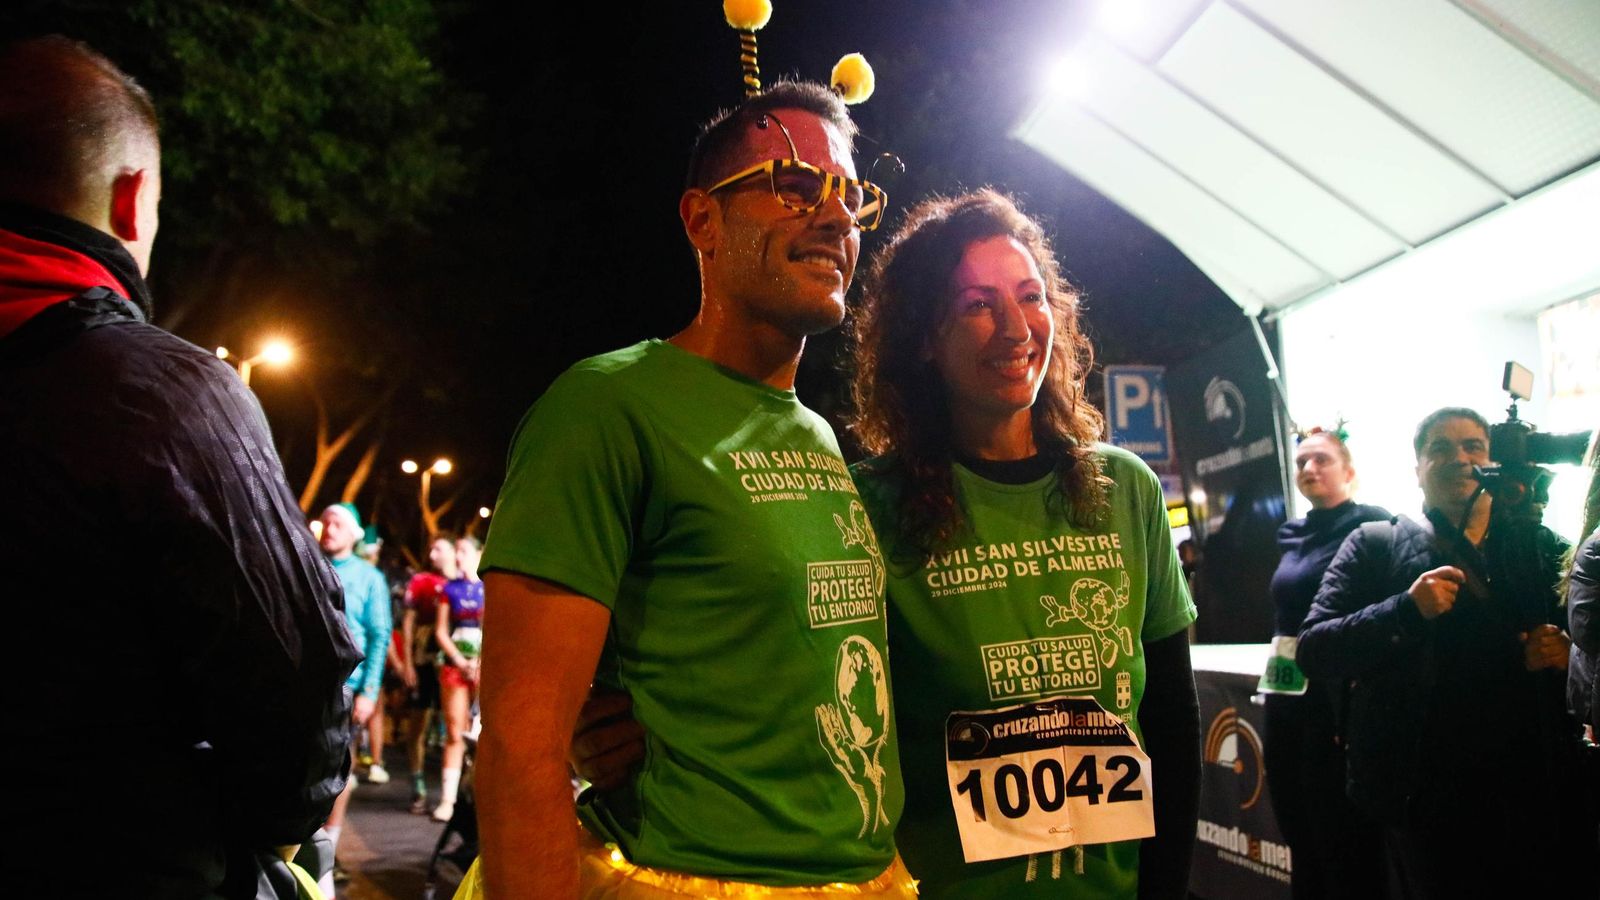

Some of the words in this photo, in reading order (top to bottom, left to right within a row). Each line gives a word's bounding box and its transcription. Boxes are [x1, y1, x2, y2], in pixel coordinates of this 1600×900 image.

[728, 451, 771, 470] XVII
[771, 450, 806, 469] SAN
[741, 472, 805, 492] CIUDAD
[806, 473, 827, 491] DE
[751, 495, 761, 503] 29
[974, 542, 1017, 562] SAN
[1022, 532, 1122, 558] SILVESTRE
[811, 566, 835, 580] CUIDA
[836, 565, 846, 577] TU
[847, 564, 870, 577] SALUD
[927, 562, 1008, 588] CIUDAD
[1014, 560, 1041, 577] DE
[1047, 550, 1125, 573] ALMERÍA
[810, 578, 873, 603] PROTEGE
[931, 589, 941, 598] 29
[943, 583, 987, 596] DICIEMBRE
[988, 580, 1008, 590] 2024
[811, 604, 828, 622] TU
[831, 600, 874, 619] ENTORNO
[987, 645, 1029, 660] CUIDA
[1031, 640, 1048, 653] TU
[1049, 638, 1092, 652] SALUD
[988, 650, 1096, 680] PROTEGE
[992, 680, 1016, 696] TU
[1021, 669, 1098, 692] ENTORNO
[956, 755, 1143, 823] 10042
